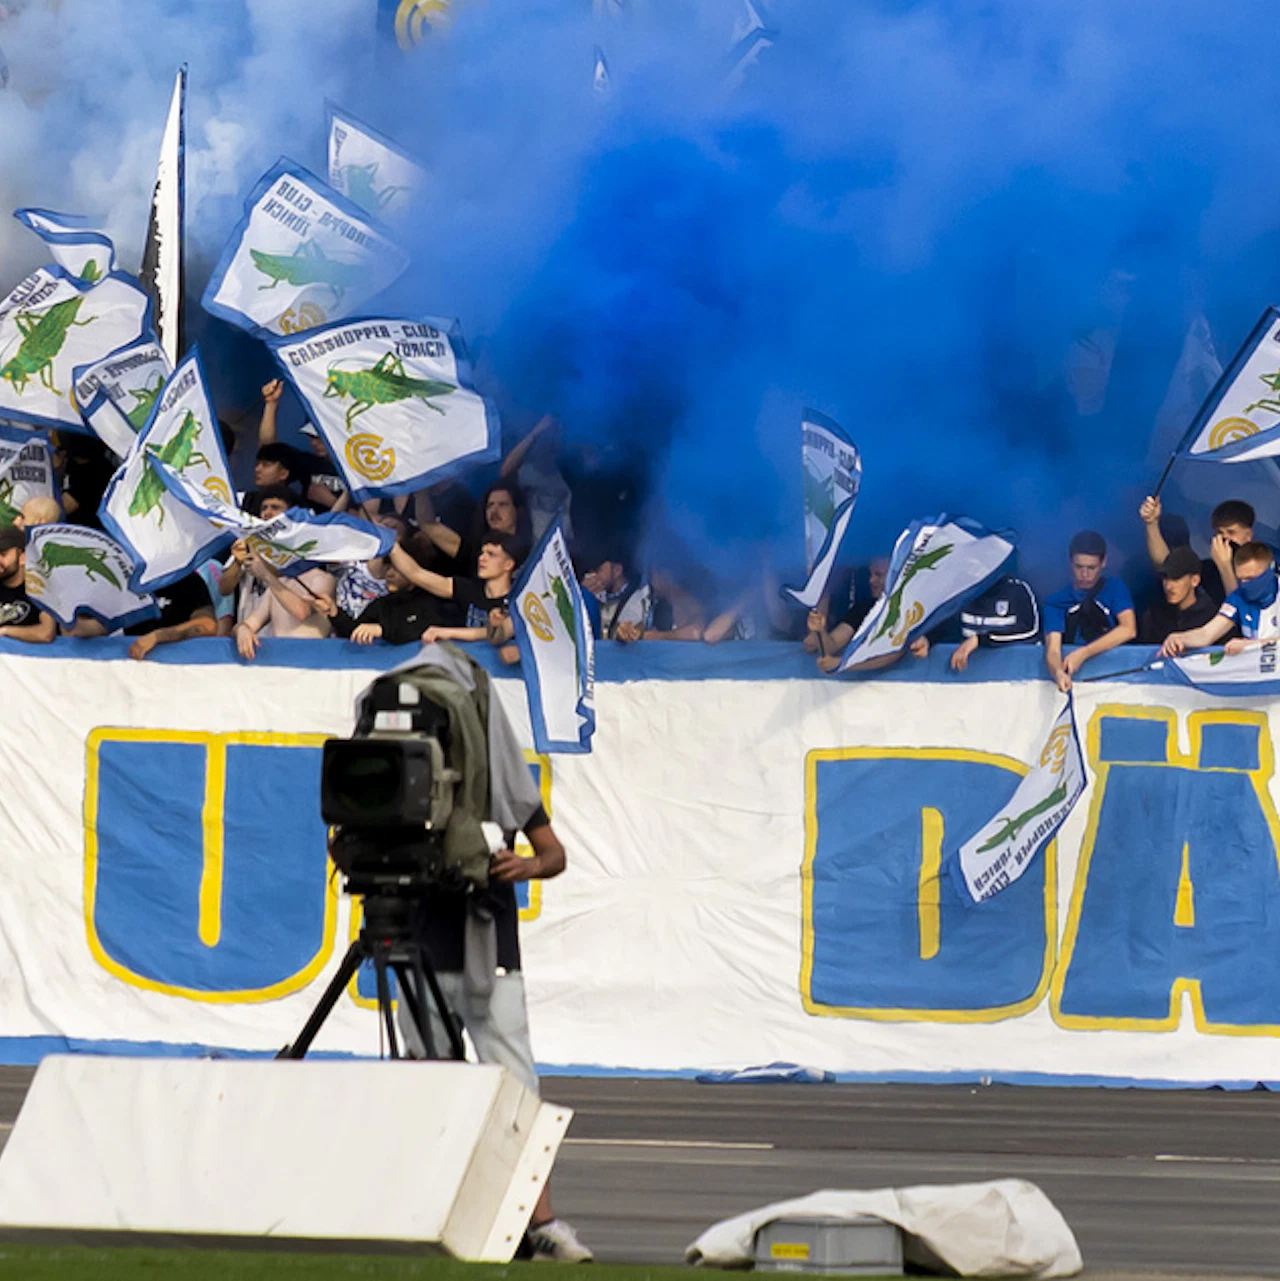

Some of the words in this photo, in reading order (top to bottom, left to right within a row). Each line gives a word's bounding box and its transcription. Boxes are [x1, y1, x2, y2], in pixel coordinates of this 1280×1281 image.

[288, 324, 391, 367] GRASSHOPPER
[401, 323, 441, 339] CLUB
[394, 340, 447, 359] ZÜRICH
[84, 724, 553, 1012] U
